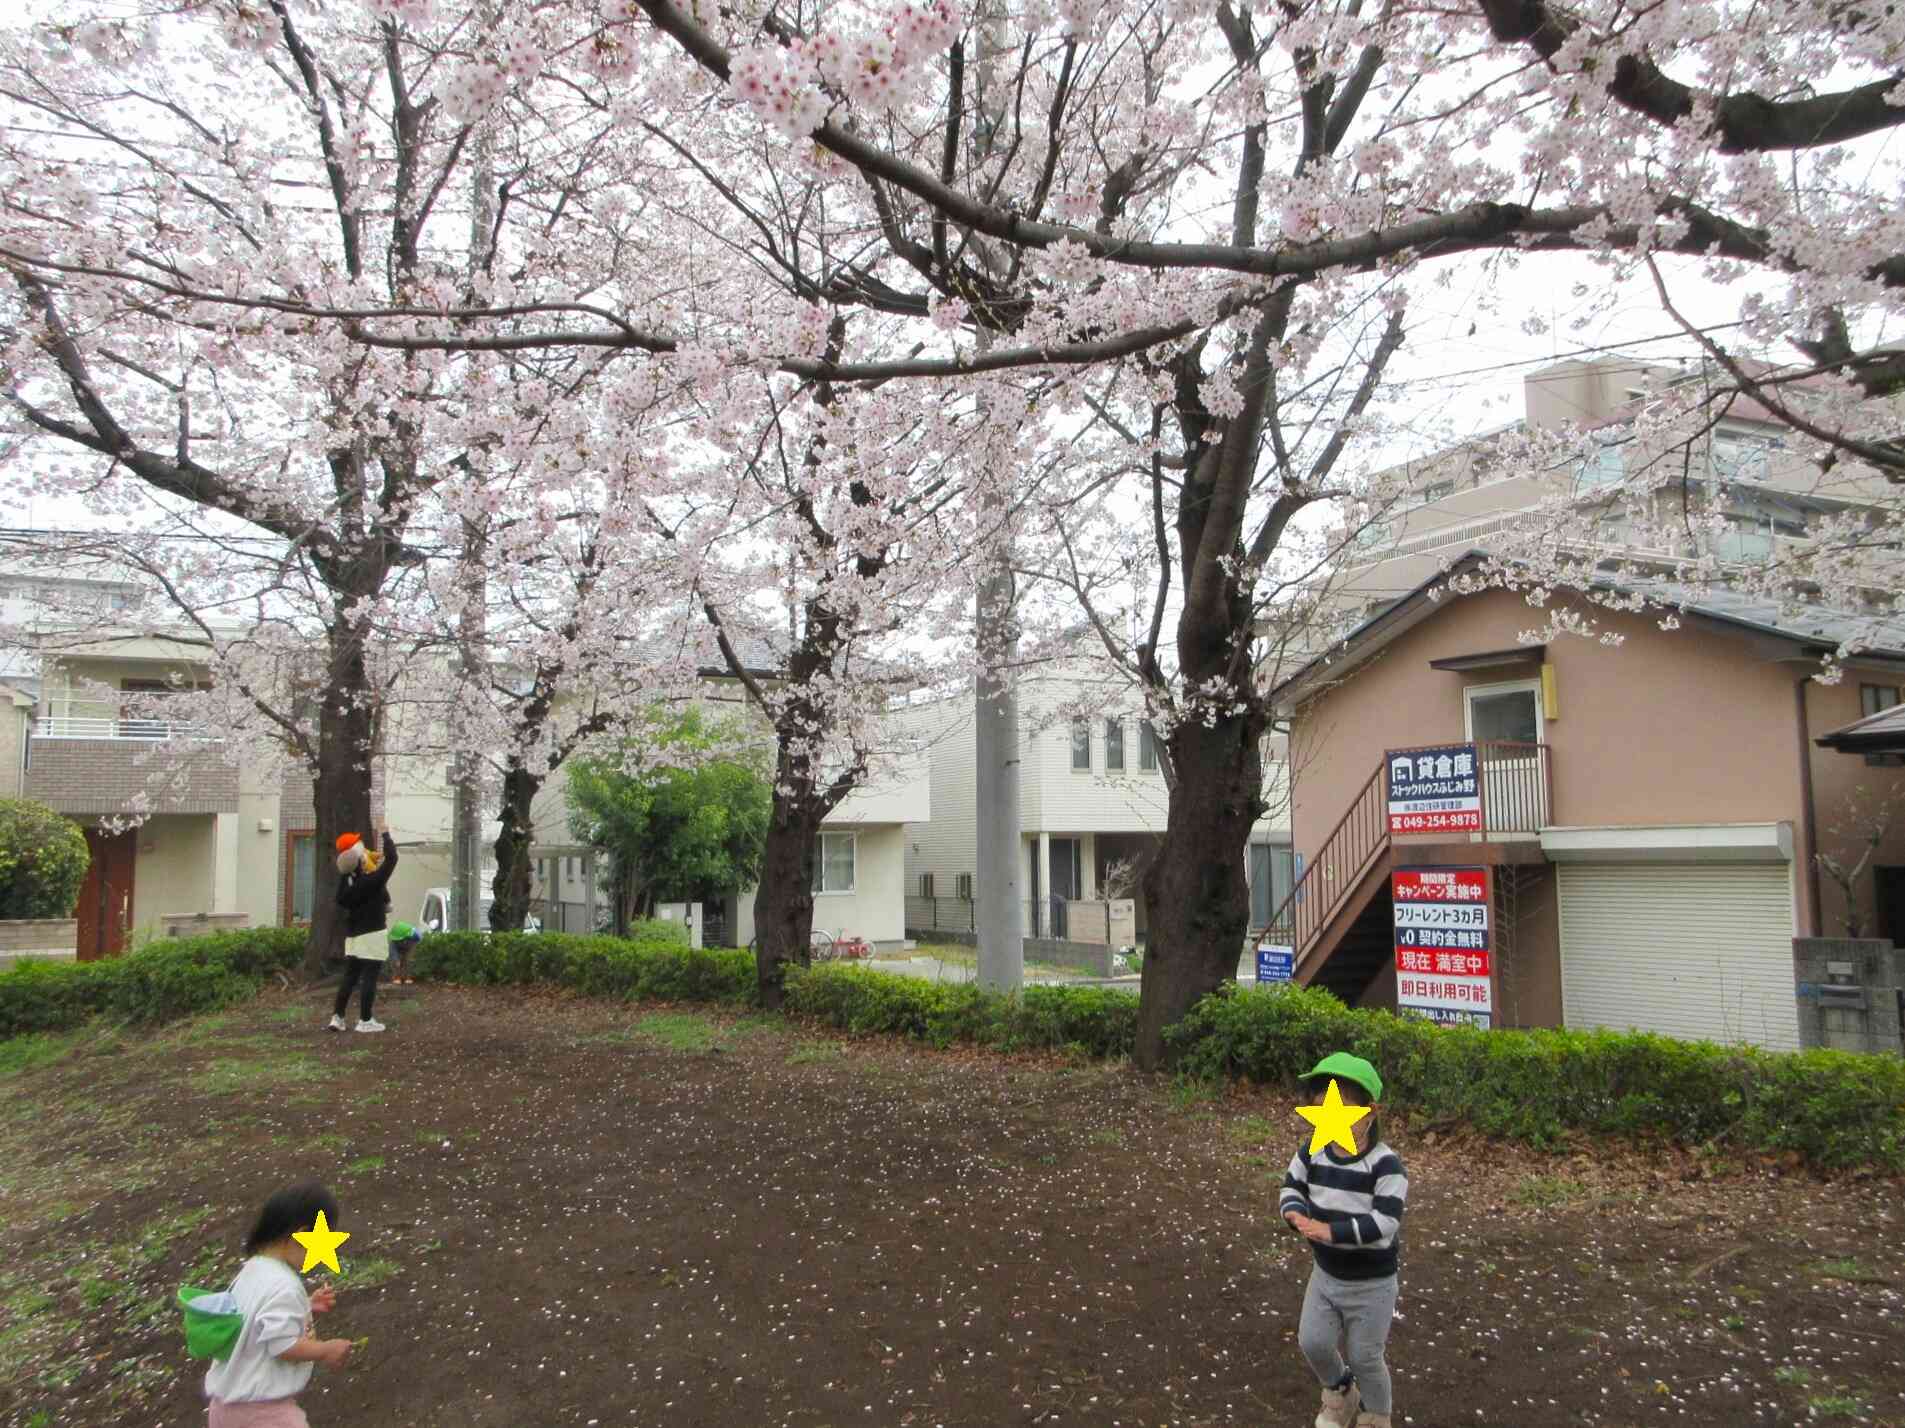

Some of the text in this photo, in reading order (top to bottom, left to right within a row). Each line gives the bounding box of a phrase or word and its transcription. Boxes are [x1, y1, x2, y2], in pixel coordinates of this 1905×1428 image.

[1416, 753, 1473, 780] 貸倉庫
[1391, 778, 1475, 797] ストックハウスふじみ野
[1403, 813, 1478, 828] 049-254-9878
[1397, 883, 1481, 900] キャンペーン実施中
[1419, 930, 1483, 948] 契約金無料
[1401, 951, 1482, 974] 現在 満室中
[1401, 980, 1488, 1003] 即日利用可能
